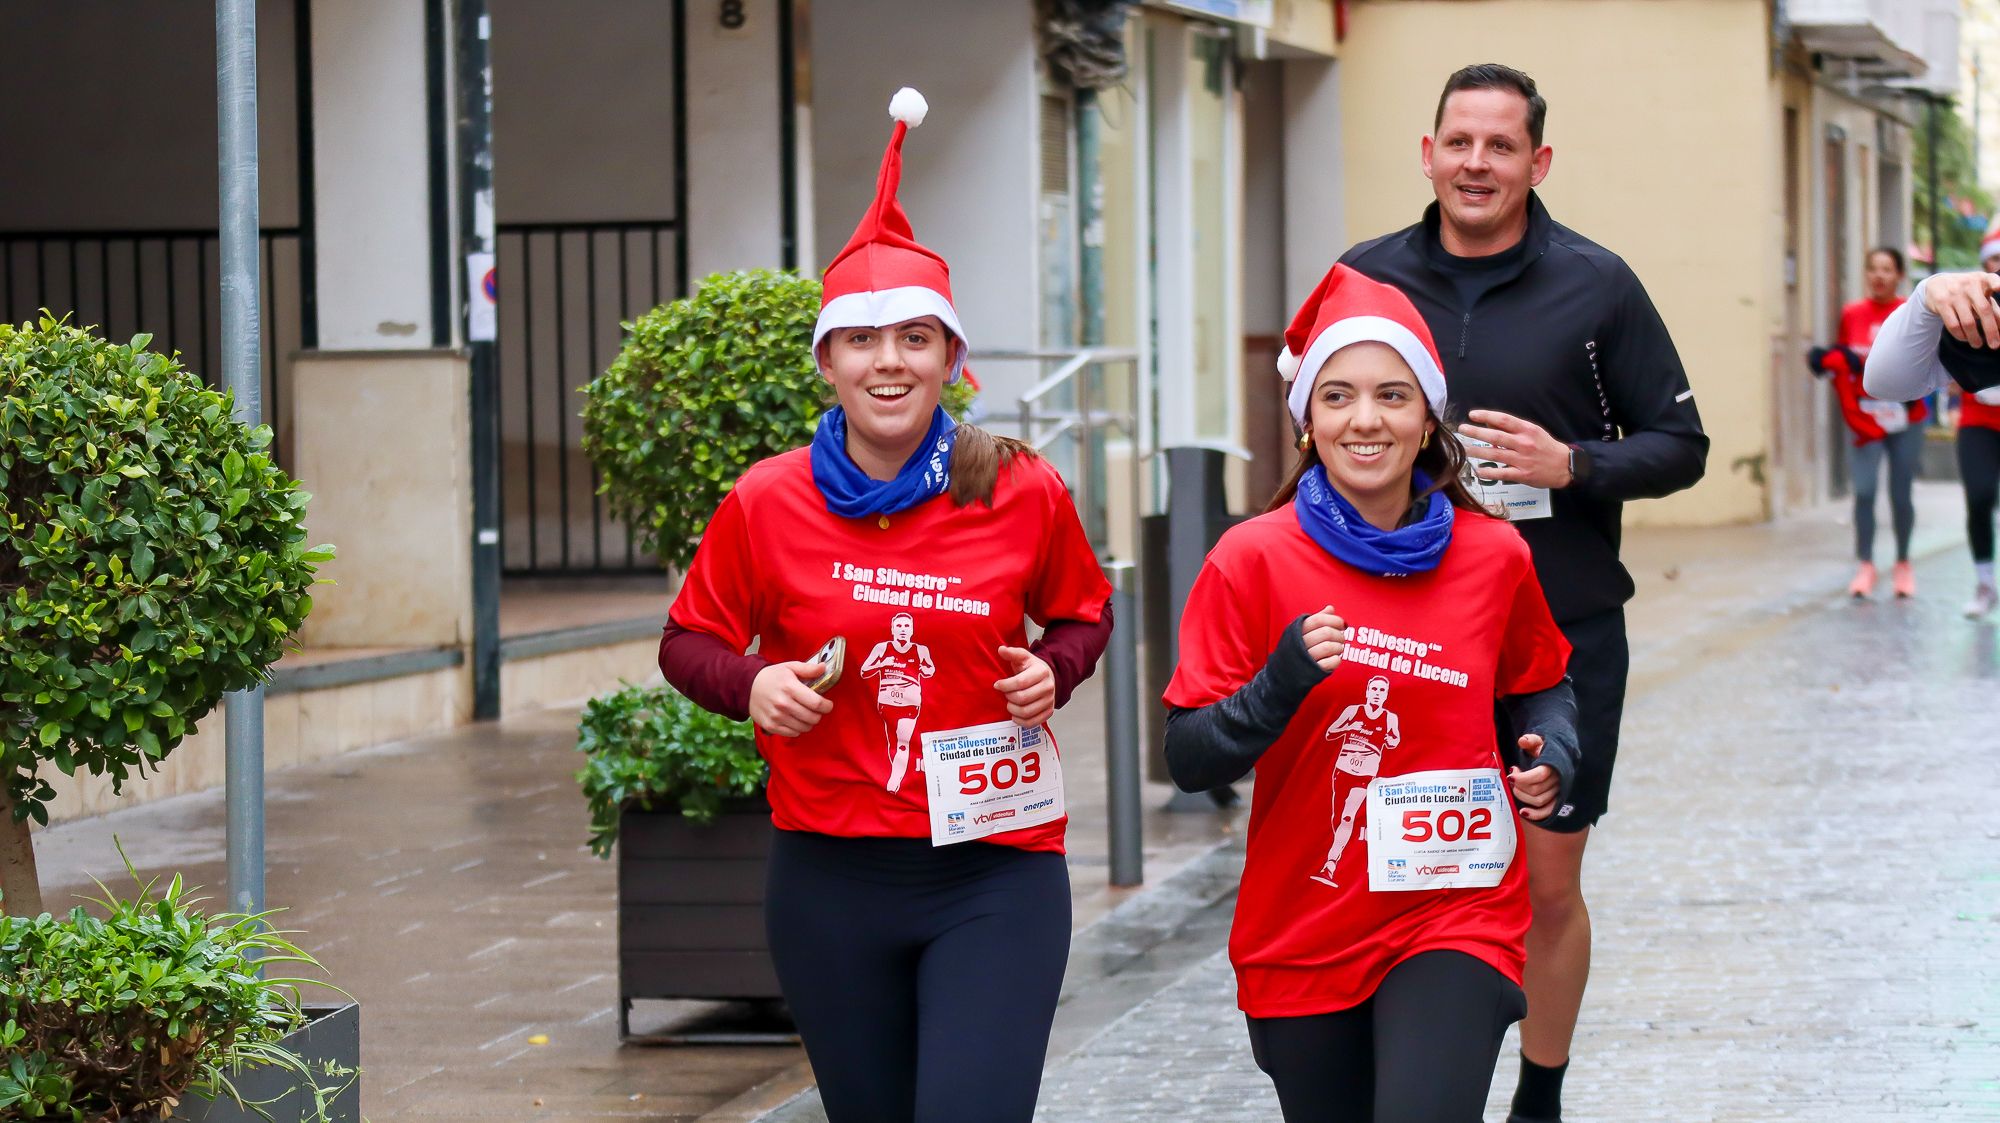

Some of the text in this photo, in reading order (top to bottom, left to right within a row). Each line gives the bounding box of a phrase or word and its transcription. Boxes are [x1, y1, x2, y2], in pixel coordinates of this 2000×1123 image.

[719, 0, 745, 29] 8
[832, 562, 842, 578] I
[843, 563, 874, 584] San
[876, 567, 948, 591] Silvestre
[852, 584, 991, 616] Ciudad de Lucena
[1356, 626, 1428, 658] Silvestre
[1340, 643, 1469, 688] iudad de Lucena
[931, 743, 938, 752] I
[939, 742, 956, 752] San
[957, 737, 998, 749] Silvestre
[940, 744, 1015, 761] Ciudad de Lucena
[959, 752, 1041, 795] 503
[1350, 757, 1363, 768] 001
[1378, 788, 1383, 797] I
[1385, 786, 1403, 796] San
[1404, 785, 1447, 794] Silvestre
[1385, 794, 1465, 805] Ciudad de Lucena
[1023, 798, 1054, 812] enerplus
[1401, 807, 1492, 843] 502
[1468, 861, 1505, 870] enerplus
